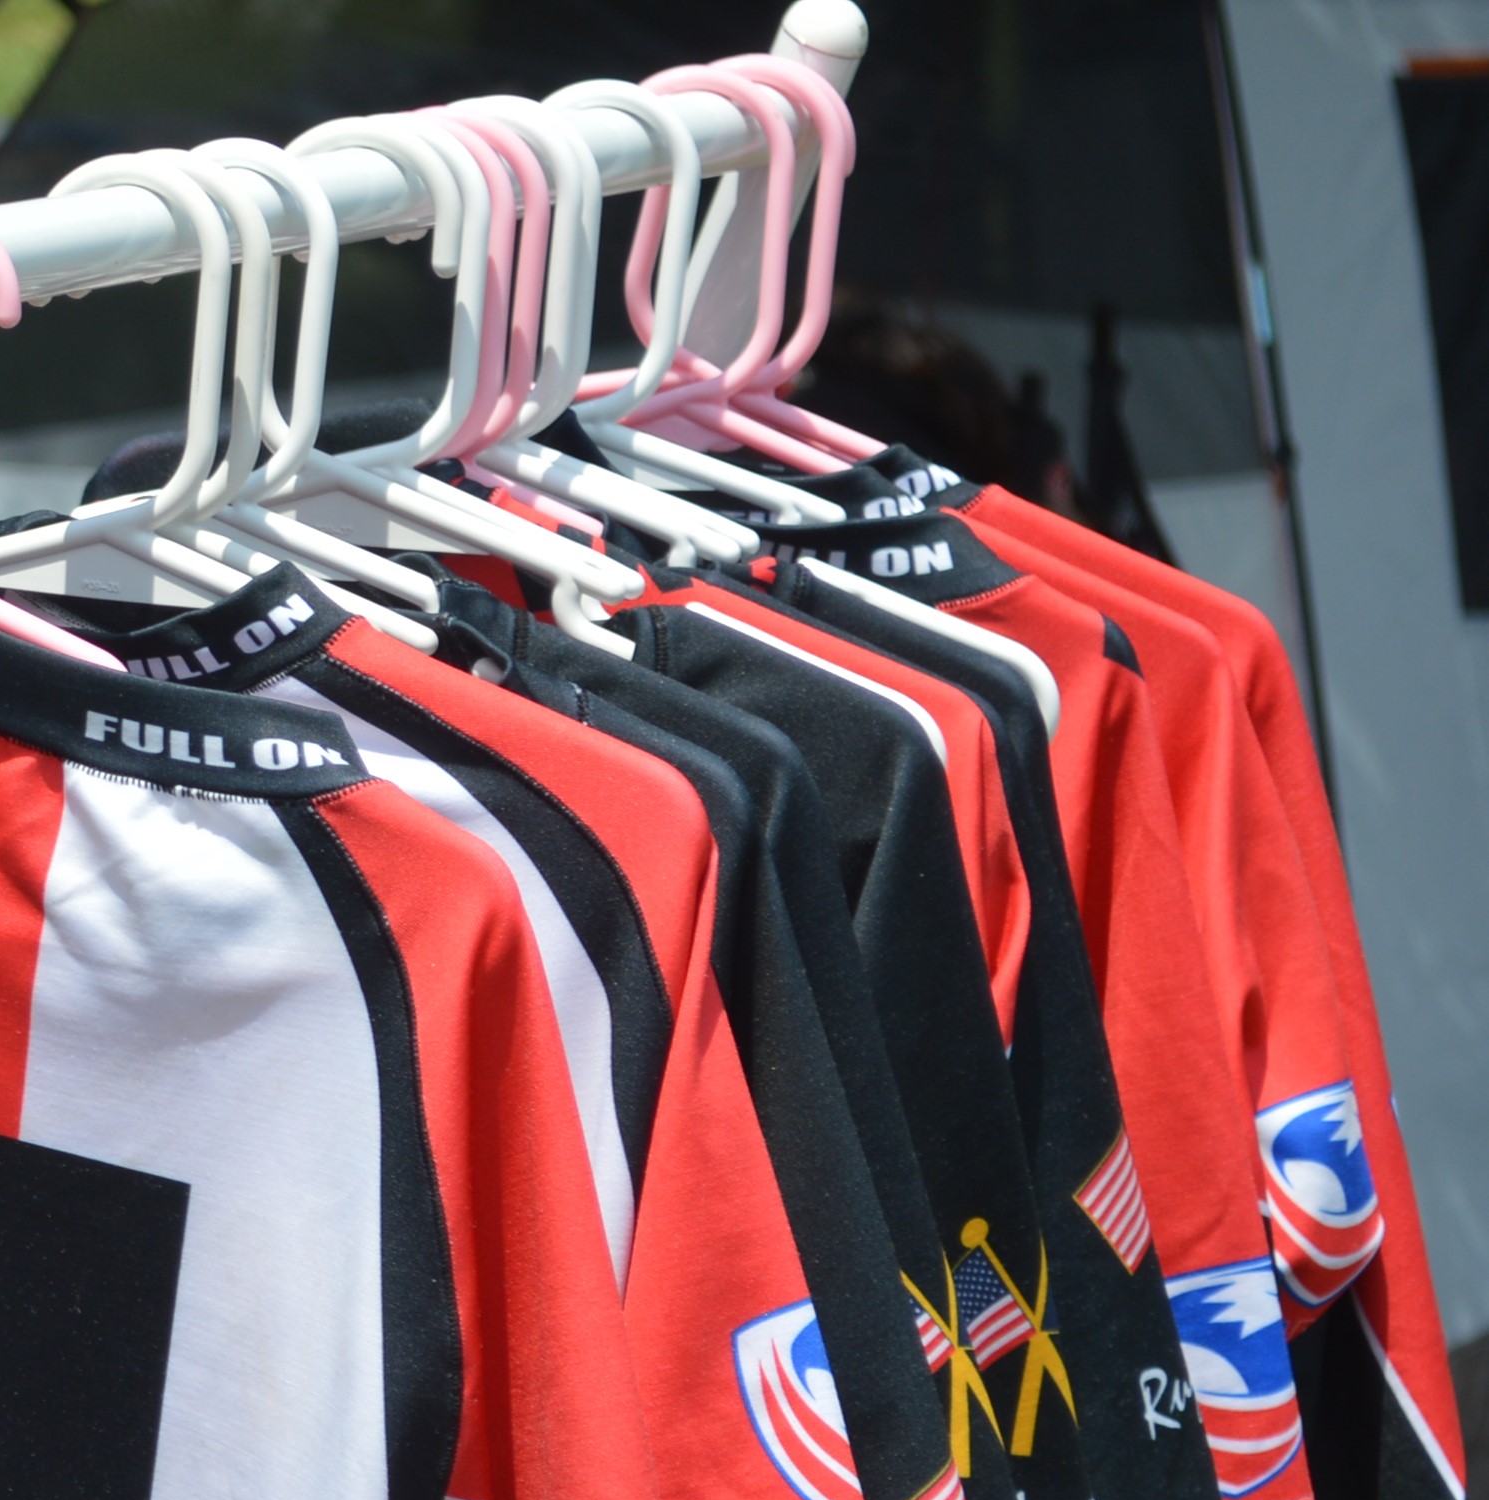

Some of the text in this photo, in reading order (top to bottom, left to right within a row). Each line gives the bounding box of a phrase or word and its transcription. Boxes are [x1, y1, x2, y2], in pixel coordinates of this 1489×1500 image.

[871, 540, 954, 577] ON
[233, 593, 315, 654] ON
[84, 710, 351, 771] FULL ON
